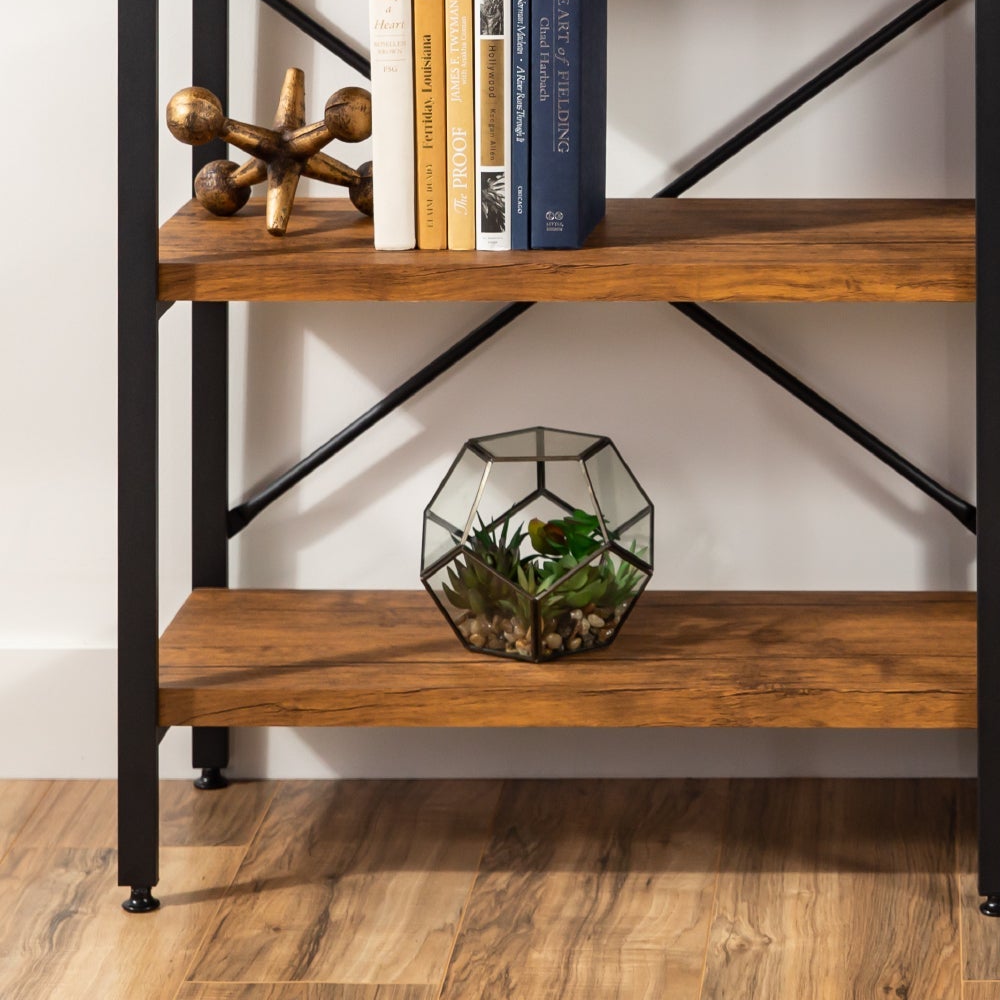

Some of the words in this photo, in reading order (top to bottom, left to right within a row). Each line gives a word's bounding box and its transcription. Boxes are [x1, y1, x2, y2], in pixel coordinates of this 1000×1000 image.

[374, 19, 405, 30] Heart
[450, 0, 460, 53] TWYMAN
[539, 16, 550, 47] Chad
[557, 8, 569, 43] ART
[422, 34, 433, 93] Louisiana
[487, 45, 497, 98] Hollywood
[539, 52, 550, 102] Harbach
[555, 47, 570, 67] of
[450, 67, 461, 103] JAMES
[422, 97, 434, 149] Ferriday,
[557, 71, 570, 153] FIELDING
[453, 127, 468, 190] PROOF
[453, 193, 468, 216] The
